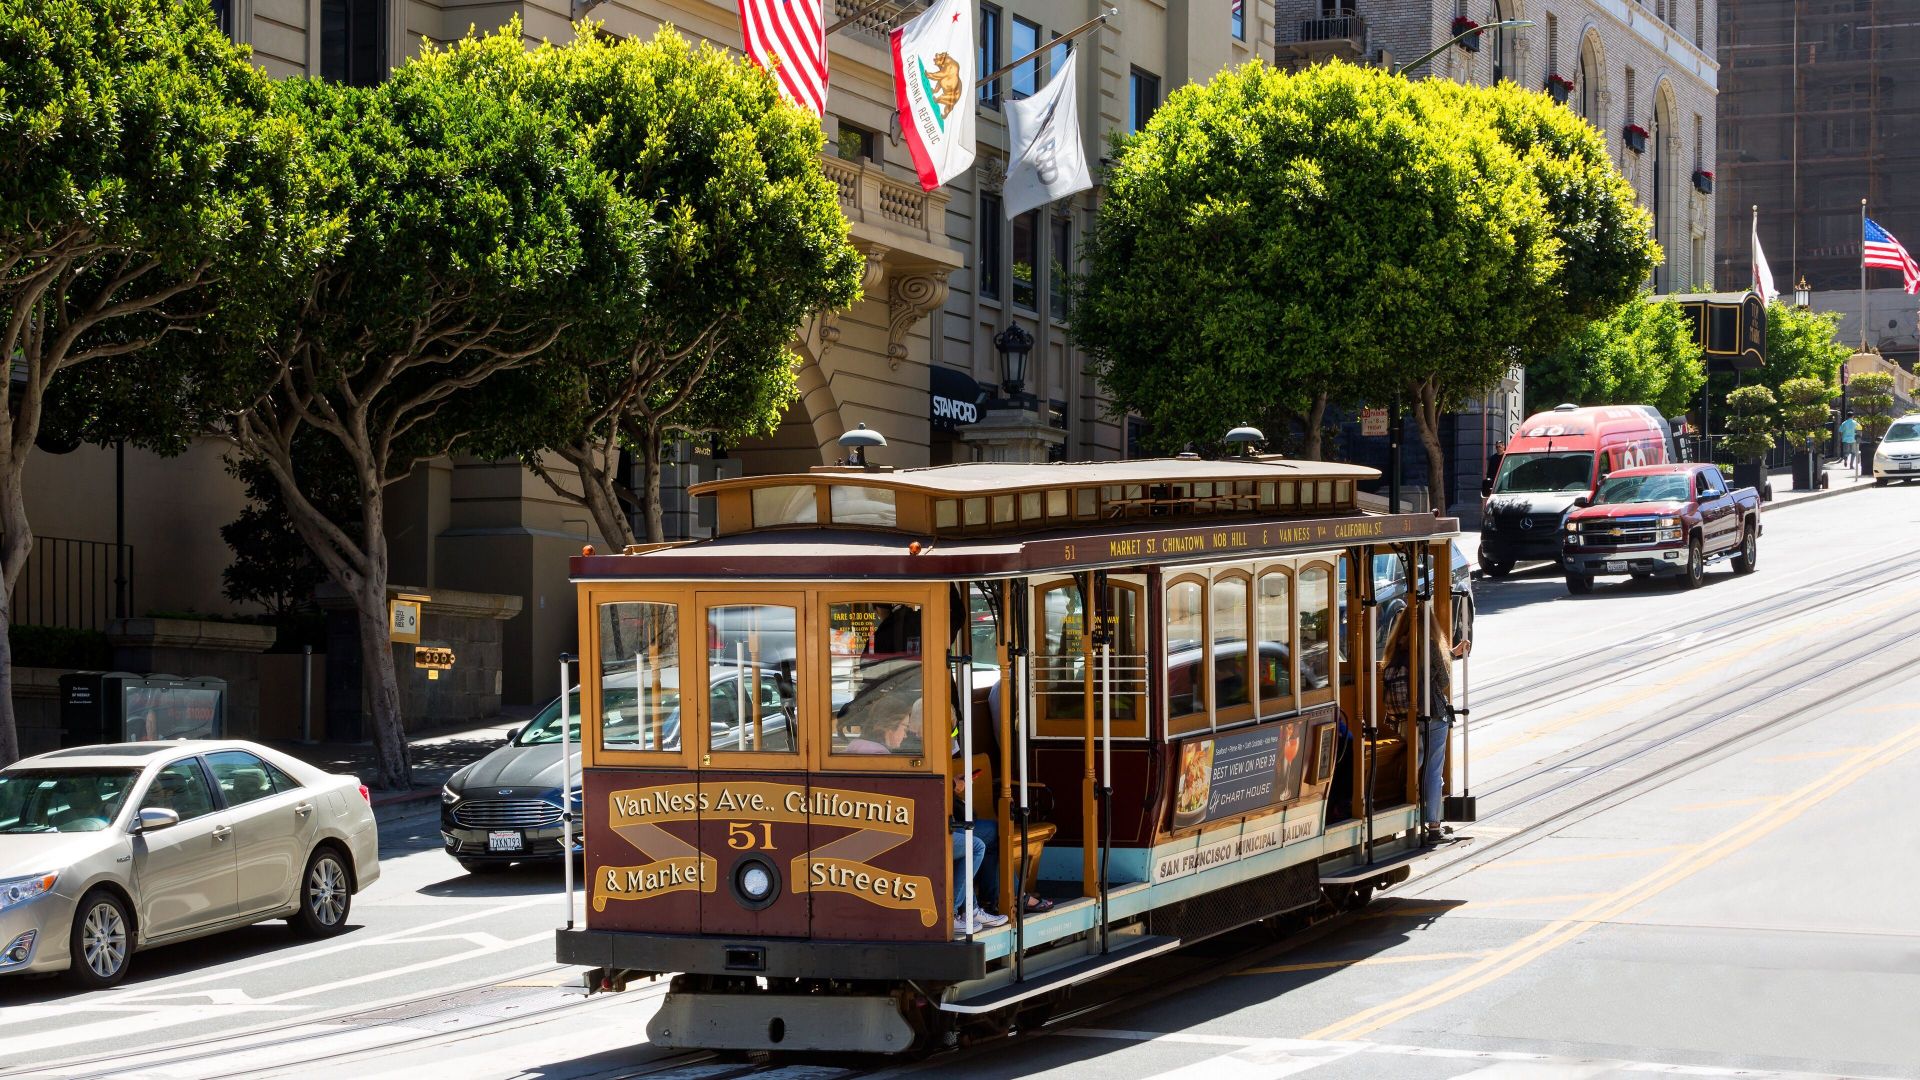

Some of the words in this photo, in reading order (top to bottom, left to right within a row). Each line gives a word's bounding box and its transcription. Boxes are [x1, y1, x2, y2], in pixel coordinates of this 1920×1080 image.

[906, 54, 923, 105] CALIFORNIA
[918, 106, 941, 145] REPUBLIC
[933, 395, 977, 423] STANFORD
[1064, 544, 1076, 561] 51
[1110, 539, 1141, 556] MARKET
[1146, 538, 1158, 554] ST.
[1162, 535, 1205, 553] CHINATOWN
[1212, 533, 1227, 548] NOB
[1231, 531, 1248, 547] HILL
[1262, 530, 1268, 545] &
[1279, 528, 1292, 543] VAN
[1293, 527, 1310, 541] NESS
[1335, 522, 1373, 538] CALIFORNIA
[863, 612, 876, 620] ONE
[1212, 765, 1228, 780] BEST
[1229, 762, 1243, 776] VIEW
[1245, 759, 1255, 773] ON
[1255, 756, 1268, 770] PIER
[1268, 754, 1276, 767] 39
[785, 791, 909, 825] California
[1220, 789, 1245, 805] CHART
[1245, 782, 1271, 798] HOUSE
[490, 838, 521, 848] 7XKN793
[727, 822, 778, 850] 51
[1160, 858, 1179, 878] SAN
[1182, 845, 1231, 871] FRANCISCO
[1235, 831, 1277, 855] MUNICIPAL
[1282, 821, 1312, 843] RAILWAY
[606, 869, 622, 892] &
[625, 862, 706, 893] Market
[811, 862, 918, 901] Streets
